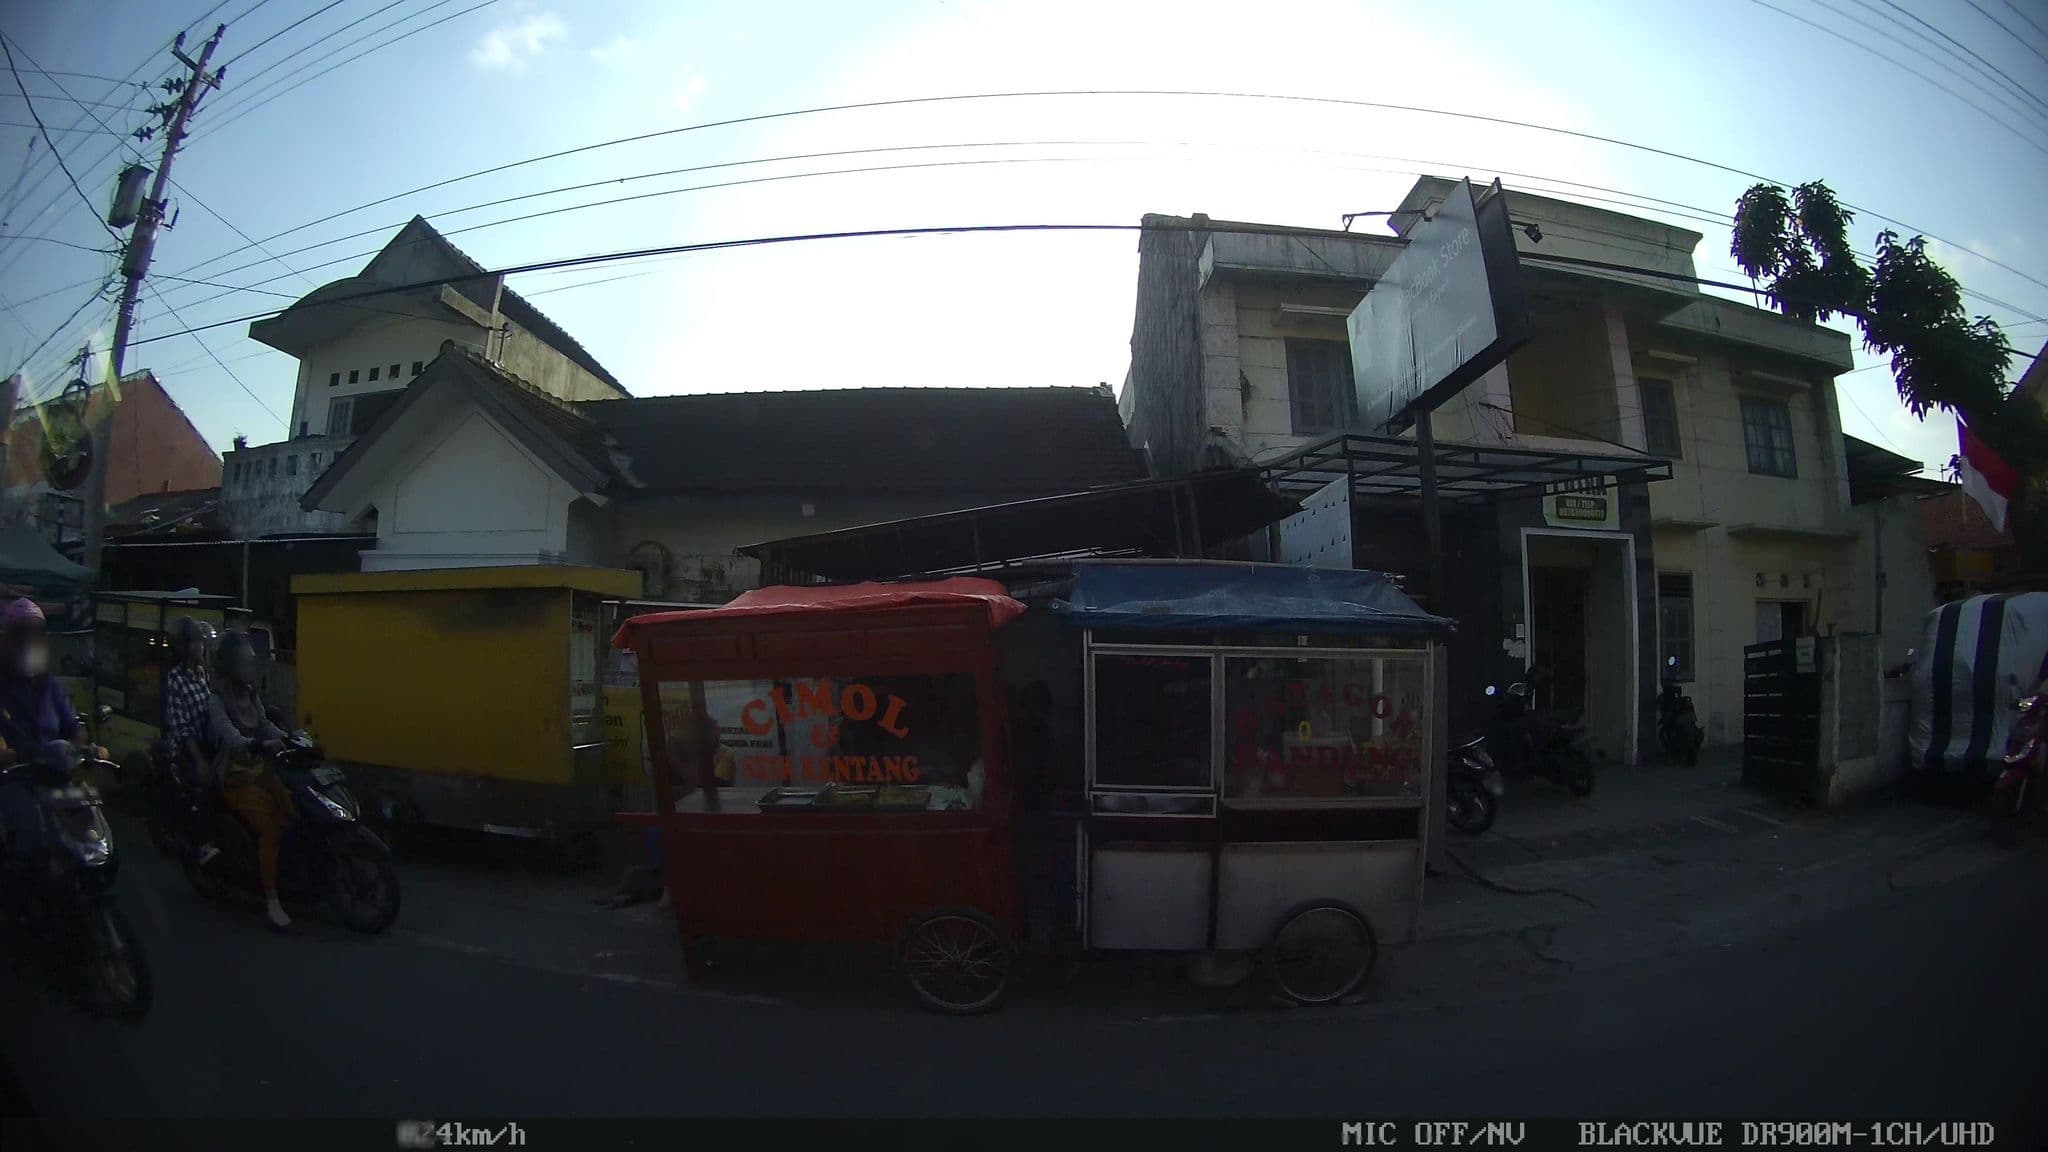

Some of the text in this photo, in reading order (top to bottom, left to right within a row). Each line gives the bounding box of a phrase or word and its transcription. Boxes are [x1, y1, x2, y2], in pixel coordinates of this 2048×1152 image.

[1400, 255, 1441, 303] acBook
[1440, 226, 1470, 269] Store
[741, 678, 911, 740] CIMOL
[800, 754, 920, 784] KENTANG
